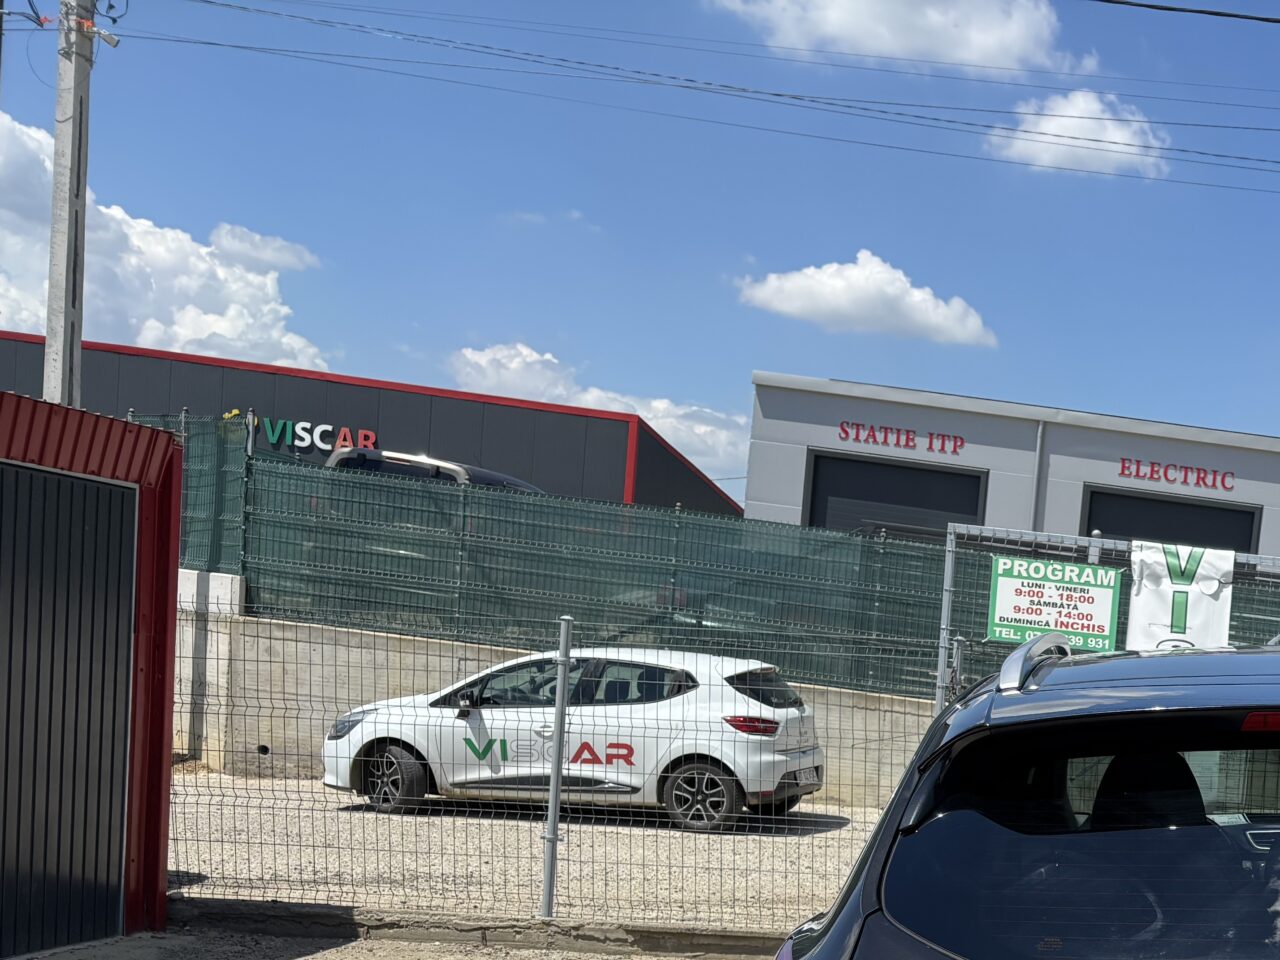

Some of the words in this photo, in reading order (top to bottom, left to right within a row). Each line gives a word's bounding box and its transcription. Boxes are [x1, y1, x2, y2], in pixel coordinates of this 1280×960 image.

[263, 417, 376, 451] VISCAR
[838, 420, 917, 450] STATIE
[926, 432, 966, 455] ITP
[1119, 458, 1236, 491] ELECTRIC
[997, 559, 1115, 586] PROGRAM
[1014, 588, 1044, 599] 9:00
[1058, 593, 1095, 605] 18:00
[1021, 581, 1045, 590] LUNI
[1055, 584, 1090, 594] VINERI
[1013, 605, 1043, 616] 9:00
[1056, 610, 1093, 622] 14:00
[993, 627, 1021, 639] TEL:
[1087, 637, 1110, 649] 931
